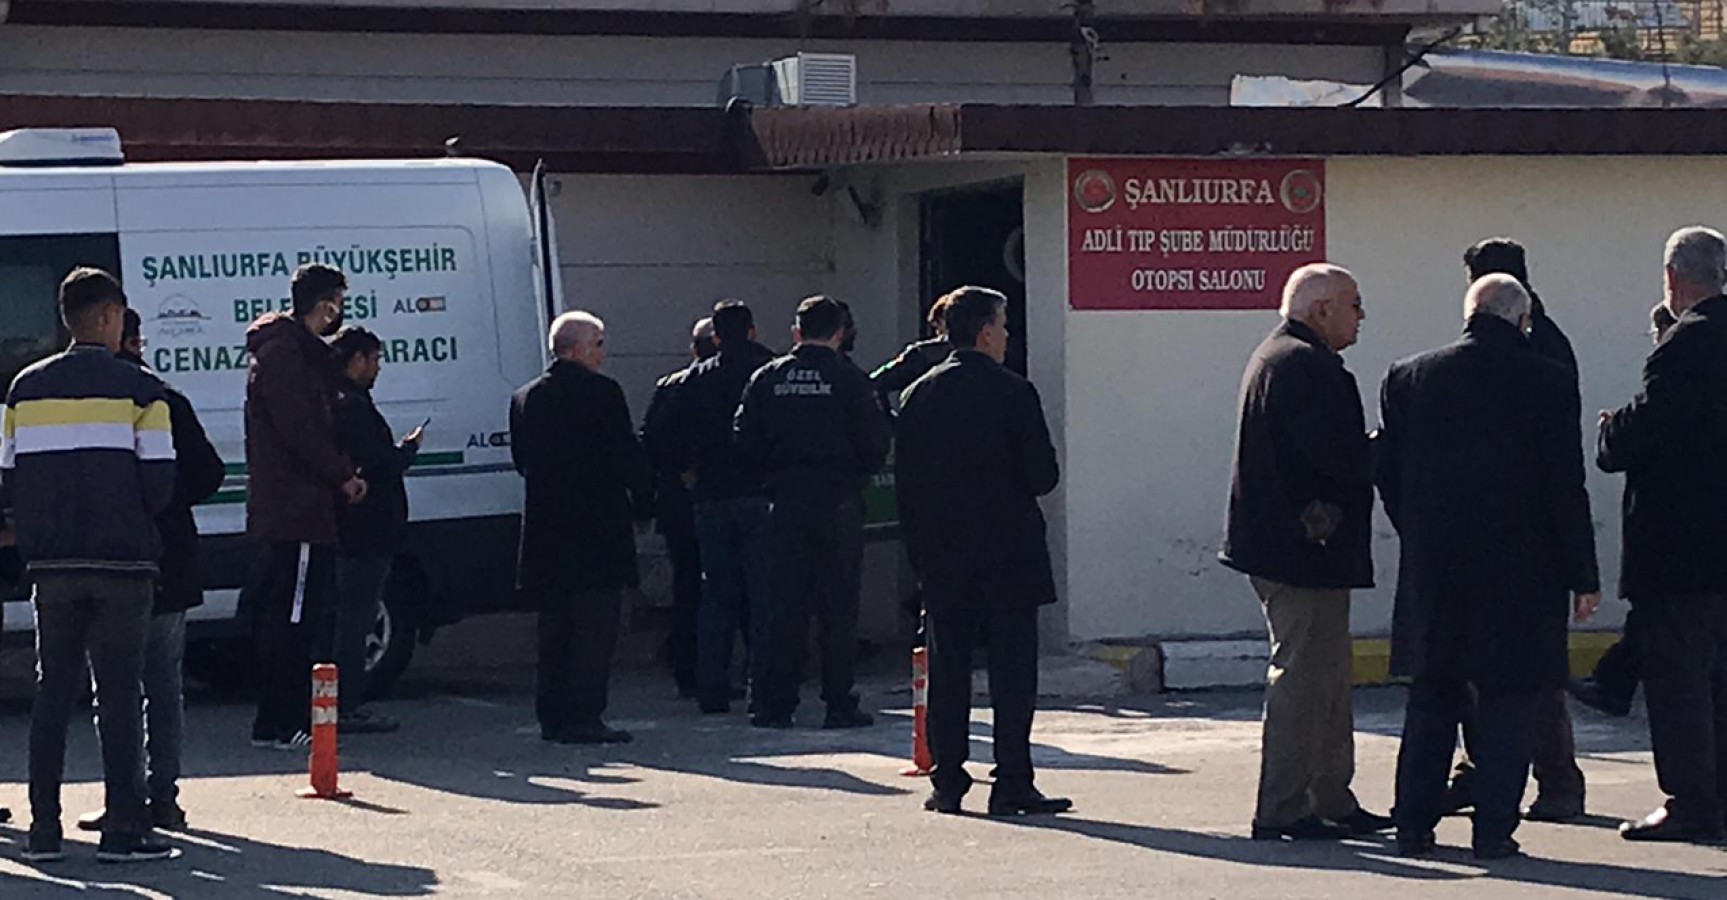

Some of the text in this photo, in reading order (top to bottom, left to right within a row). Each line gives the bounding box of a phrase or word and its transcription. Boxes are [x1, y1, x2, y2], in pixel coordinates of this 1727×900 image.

[1124, 178, 1275, 211] ŞANLIURFA
[1082, 224, 1122, 252] ADLİ
[1127, 229, 1155, 252] TIP
[1160, 229, 1204, 258] ŞUBE
[142, 252, 289, 287] ŞANLIURFA
[1200, 269, 1266, 290] SALONU
